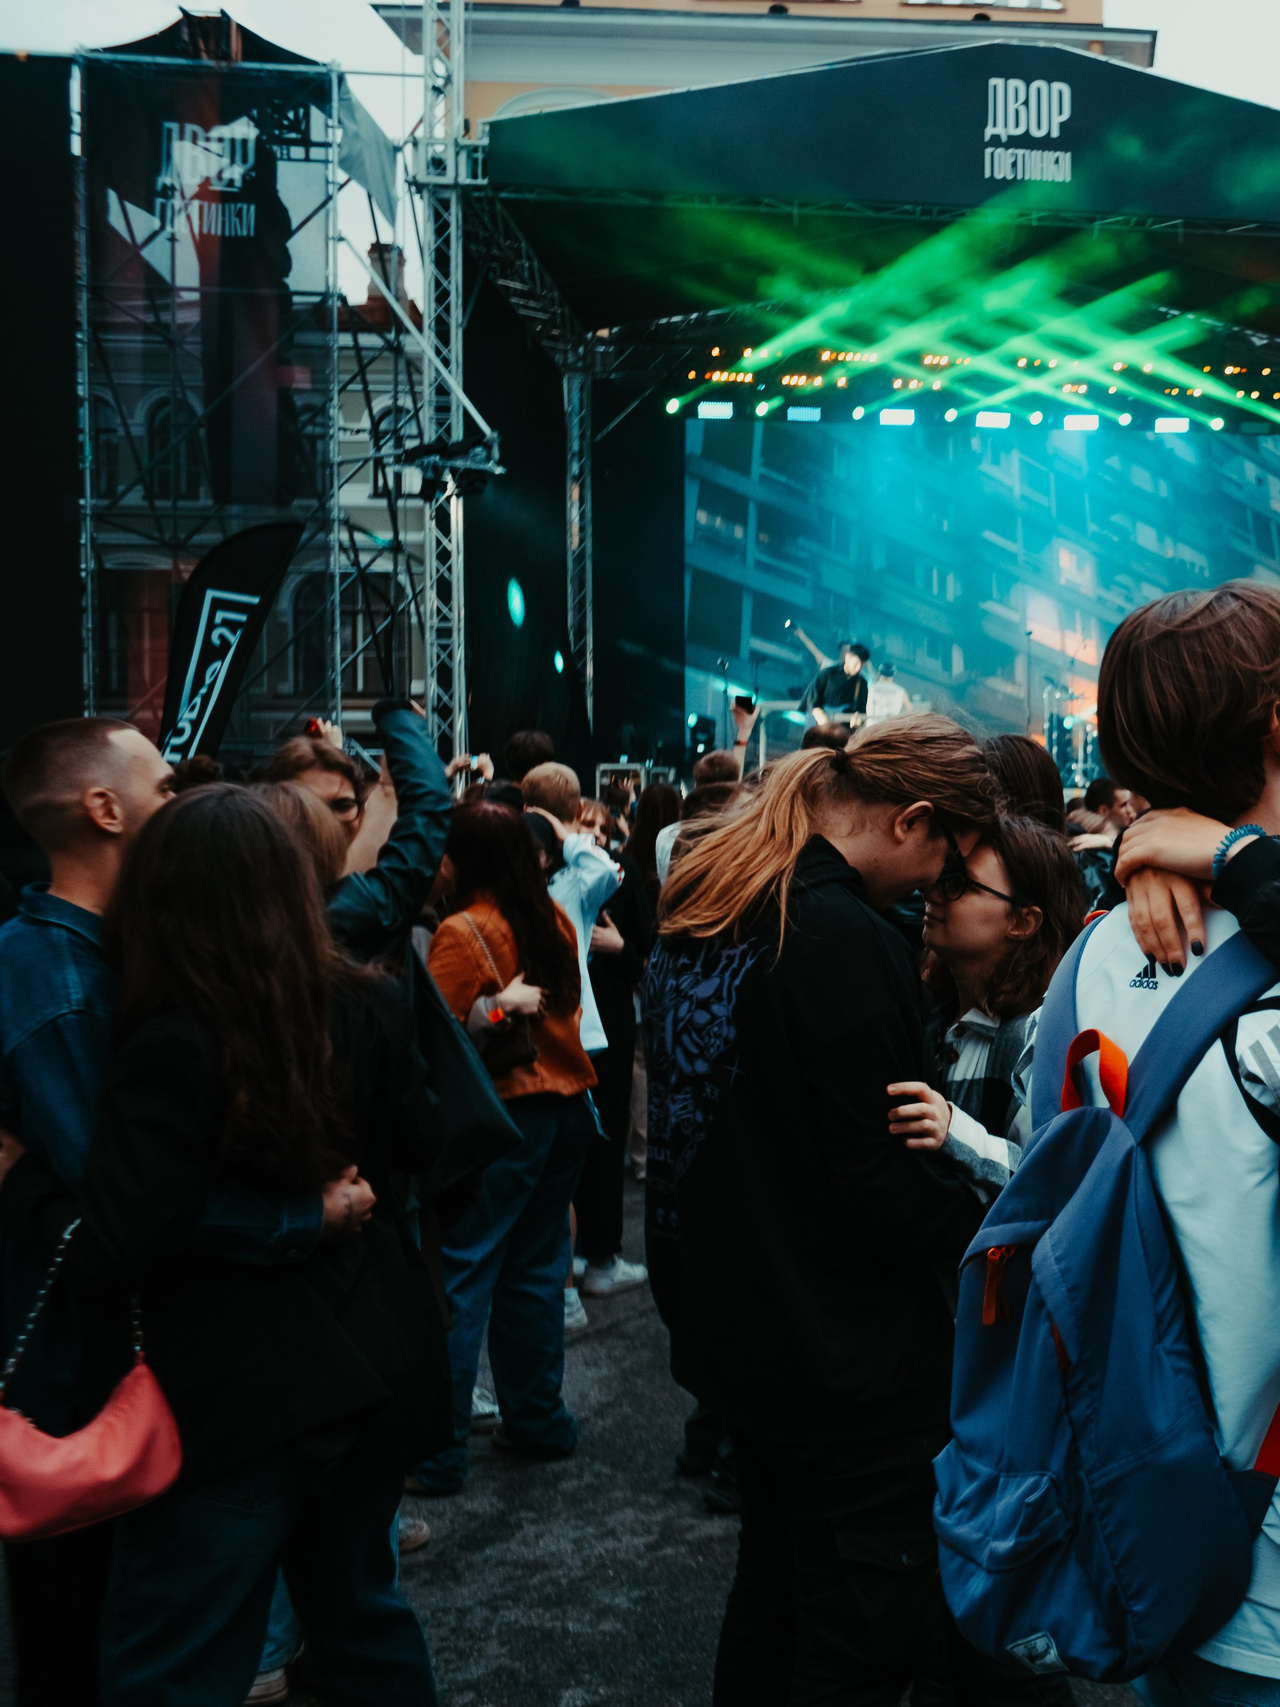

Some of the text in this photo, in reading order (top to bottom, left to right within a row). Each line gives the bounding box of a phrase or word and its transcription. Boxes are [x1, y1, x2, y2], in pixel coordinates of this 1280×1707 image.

[984, 77, 1072, 143] ДВОР
[156, 121, 257, 192] ДВОР
[984, 147, 1072, 183] ГОСТИНКИ
[210, 609, 248, 648] 21
[1129, 978, 1158, 990] adidas
